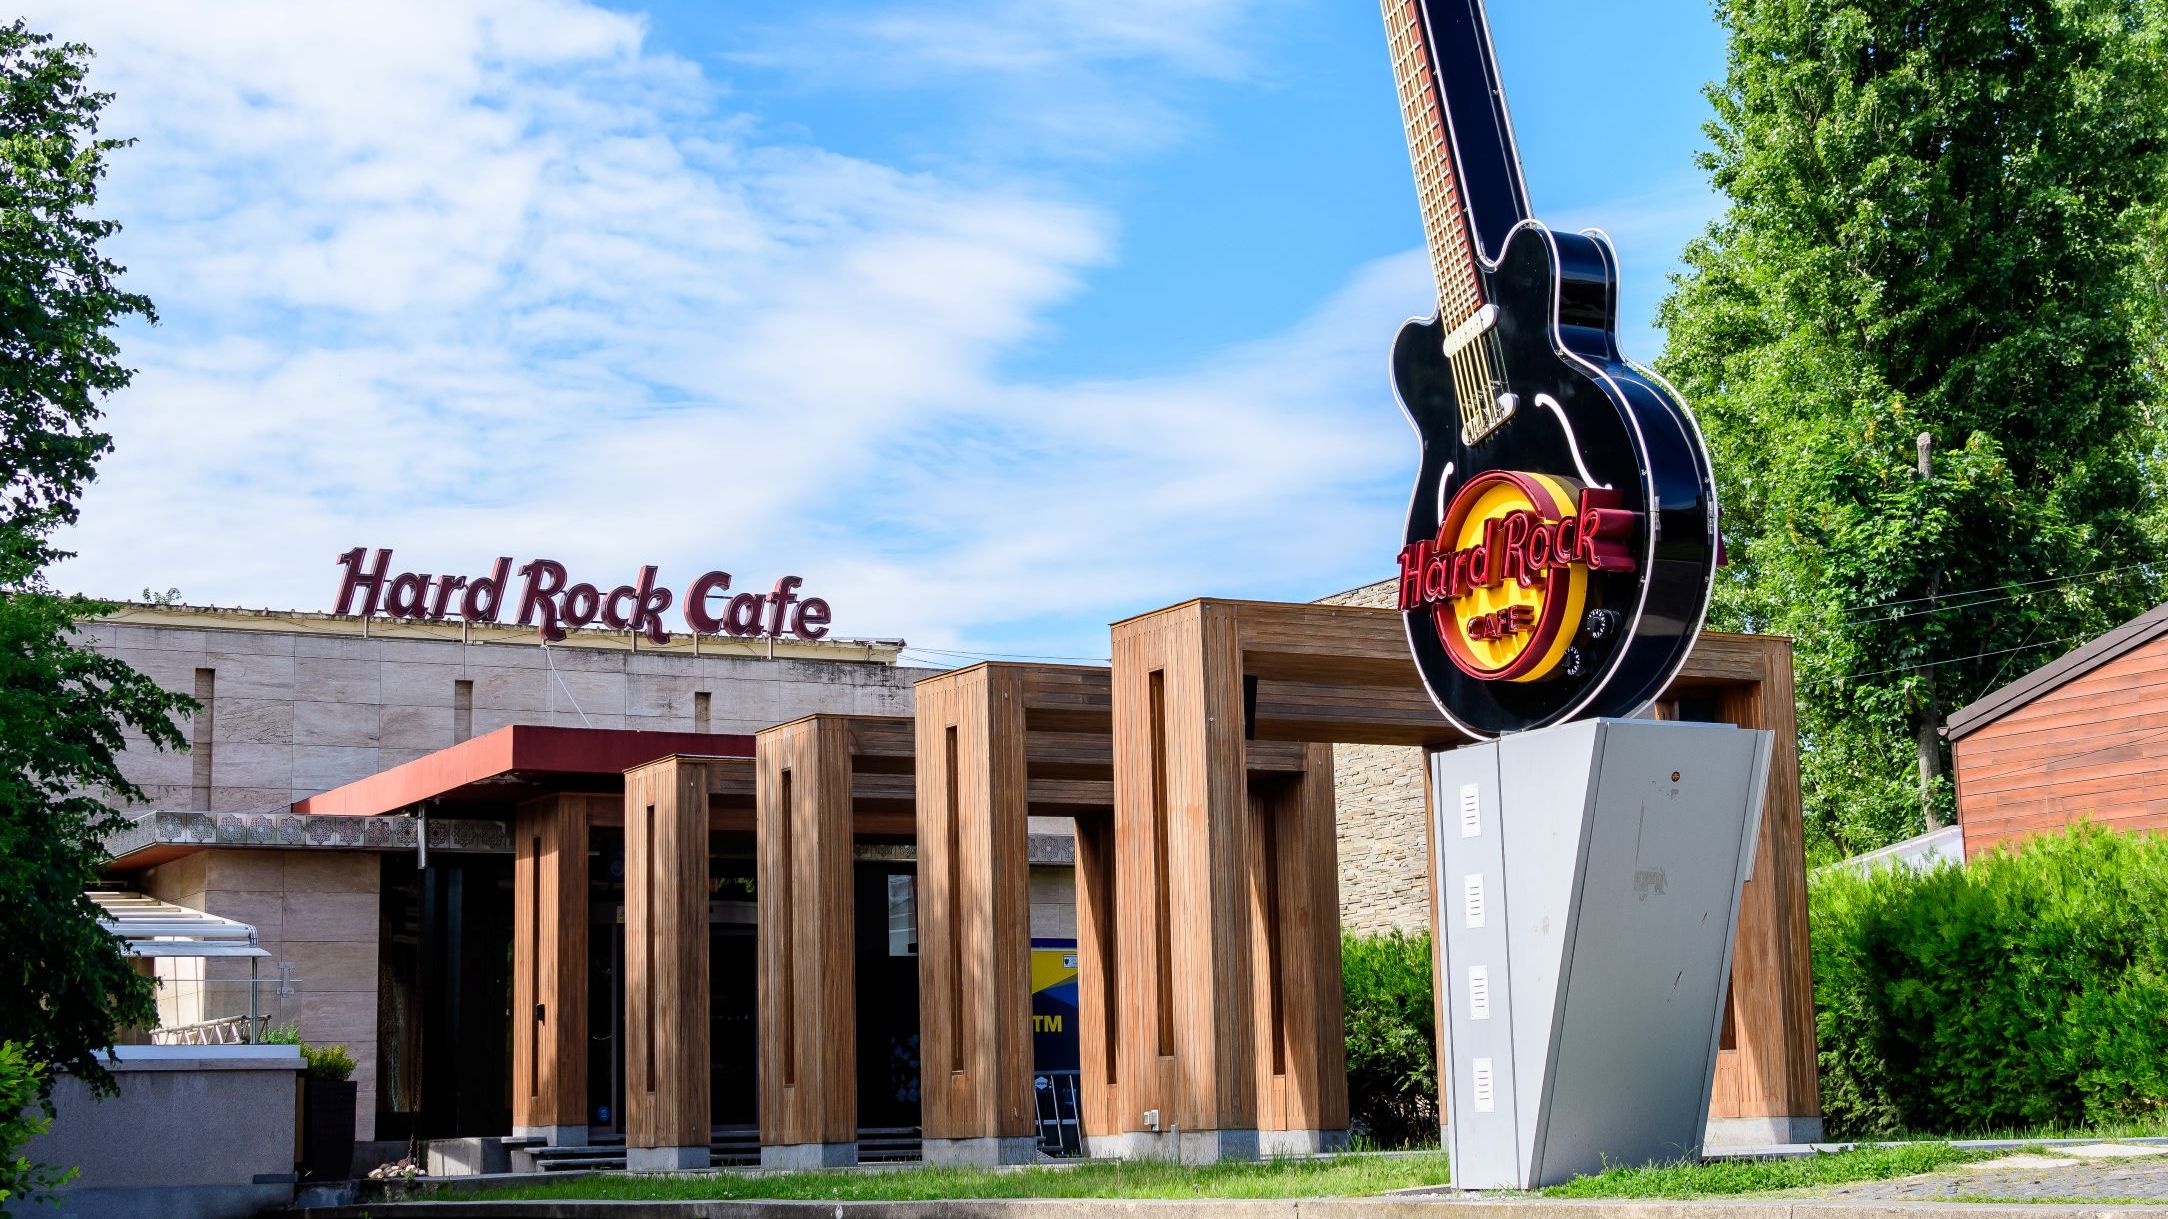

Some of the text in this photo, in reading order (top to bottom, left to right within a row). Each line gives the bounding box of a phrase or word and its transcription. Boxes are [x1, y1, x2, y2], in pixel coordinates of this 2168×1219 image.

[1397, 487, 1606, 612] Hard Rock
[334, 547, 832, 645] Hard Rock Cafe
[1467, 605, 1527, 641] CAFE
[1033, 1015, 1062, 1032] TM
